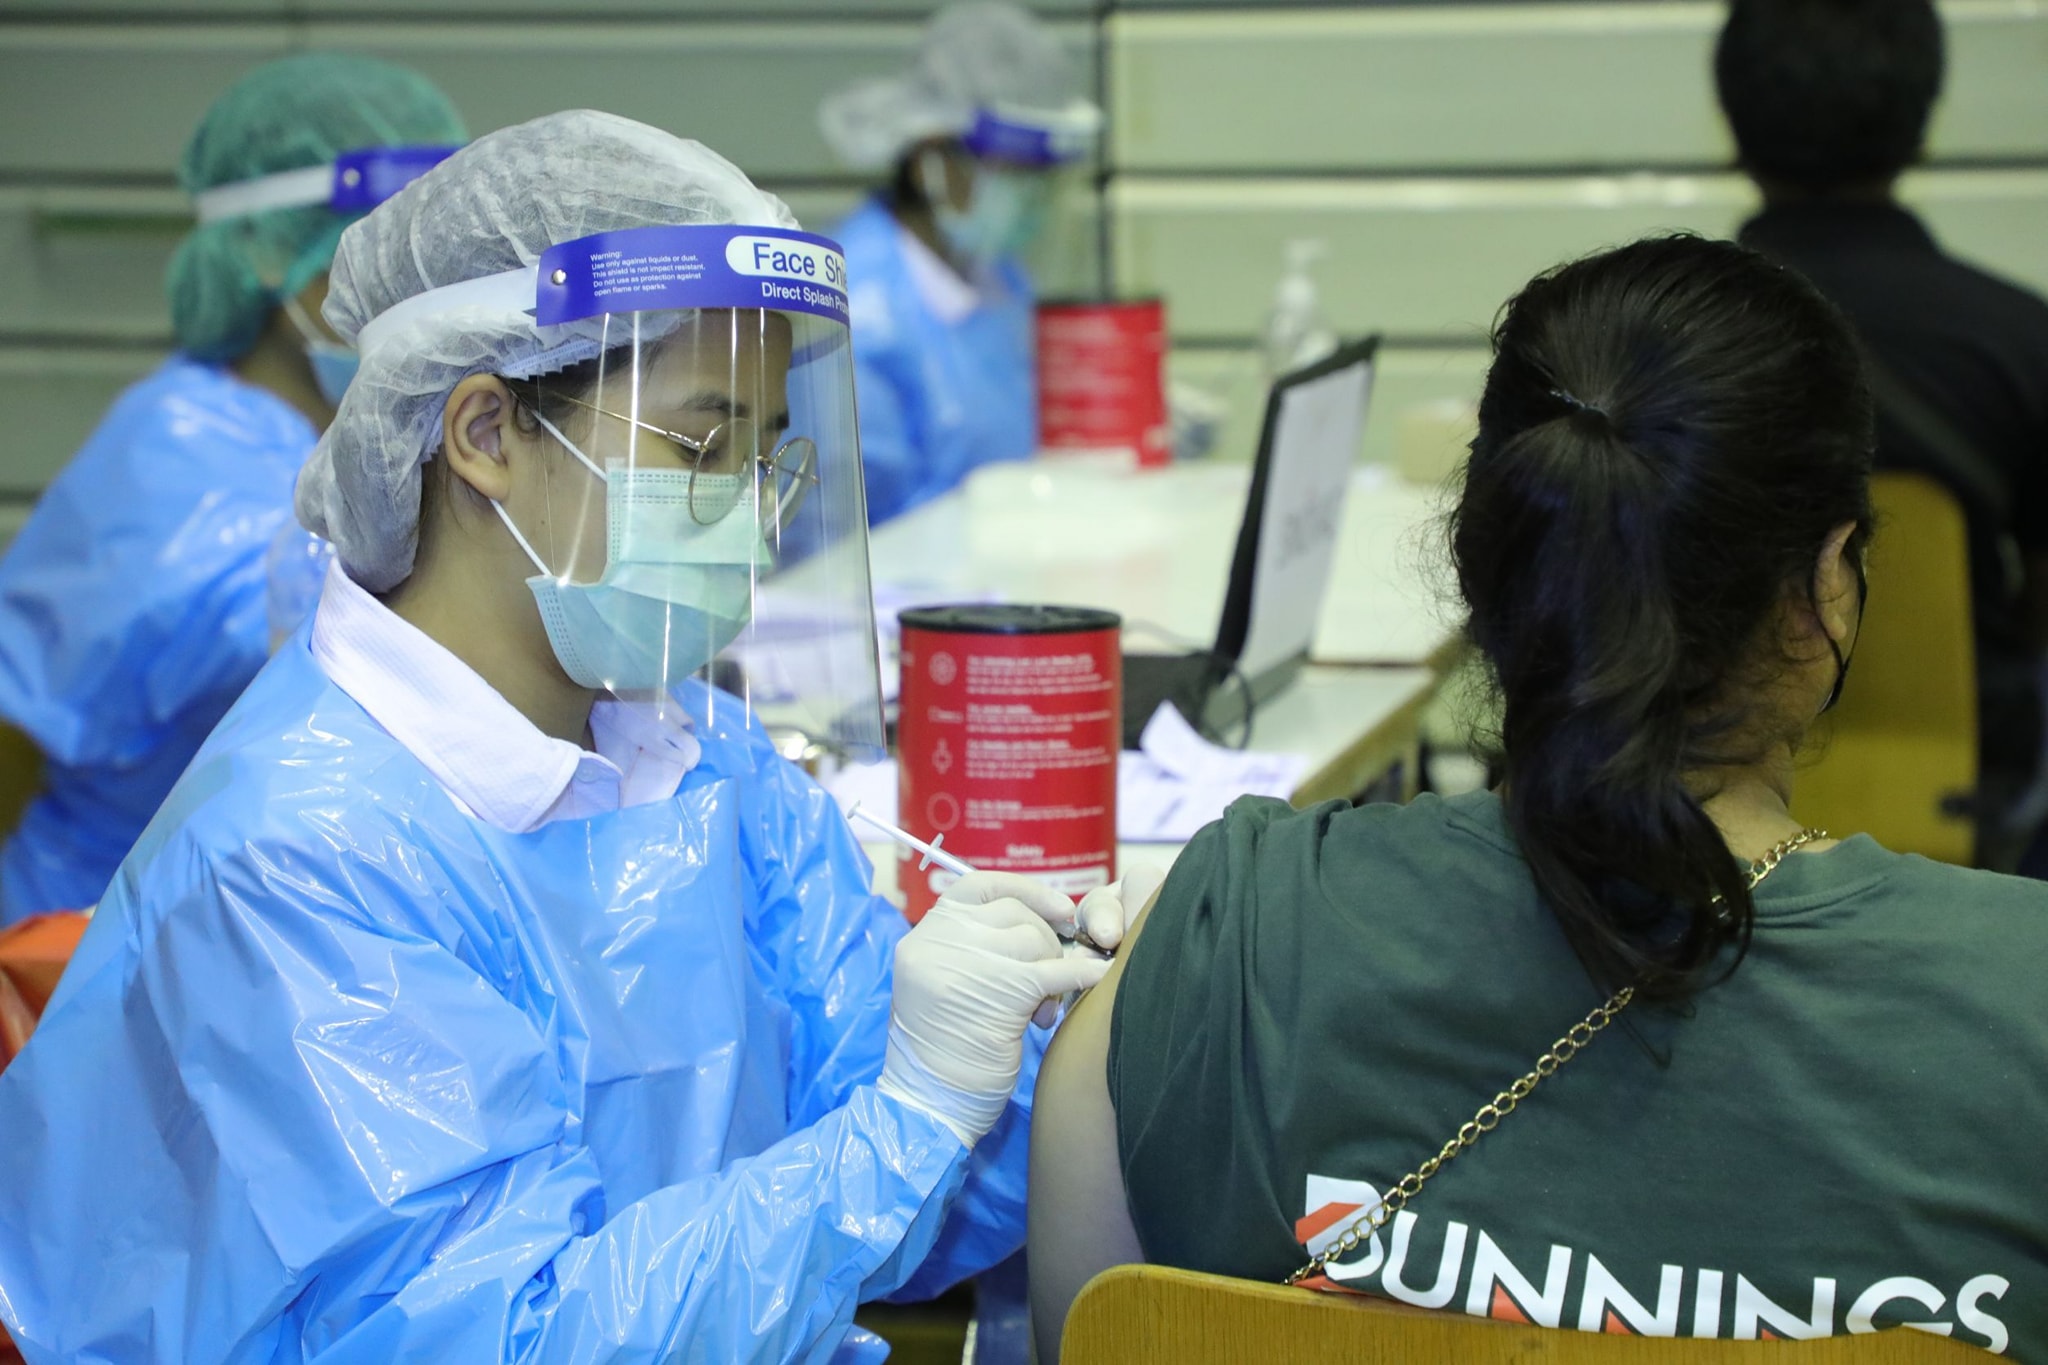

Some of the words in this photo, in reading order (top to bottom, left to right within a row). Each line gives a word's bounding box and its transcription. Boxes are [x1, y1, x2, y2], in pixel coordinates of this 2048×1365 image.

[590, 251, 623, 261] Warning:
[605, 260, 620, 268] only
[622, 257, 647, 267] against
[648, 255, 671, 265] liquids
[753, 242, 815, 276] Face
[593, 271, 607, 279] This
[608, 267, 629, 277] shield
[650, 264, 673, 273] impact
[593, 280, 603, 288] Do
[604, 278, 616, 286] not
[640, 273, 675, 283] protection
[676, 272, 701, 281] against
[594, 288, 611, 297] open
[761, 282, 801, 300] Direct
[803, 286, 835, 308] Splash
[1304, 1173, 2011, 1354] BUNNINGS
